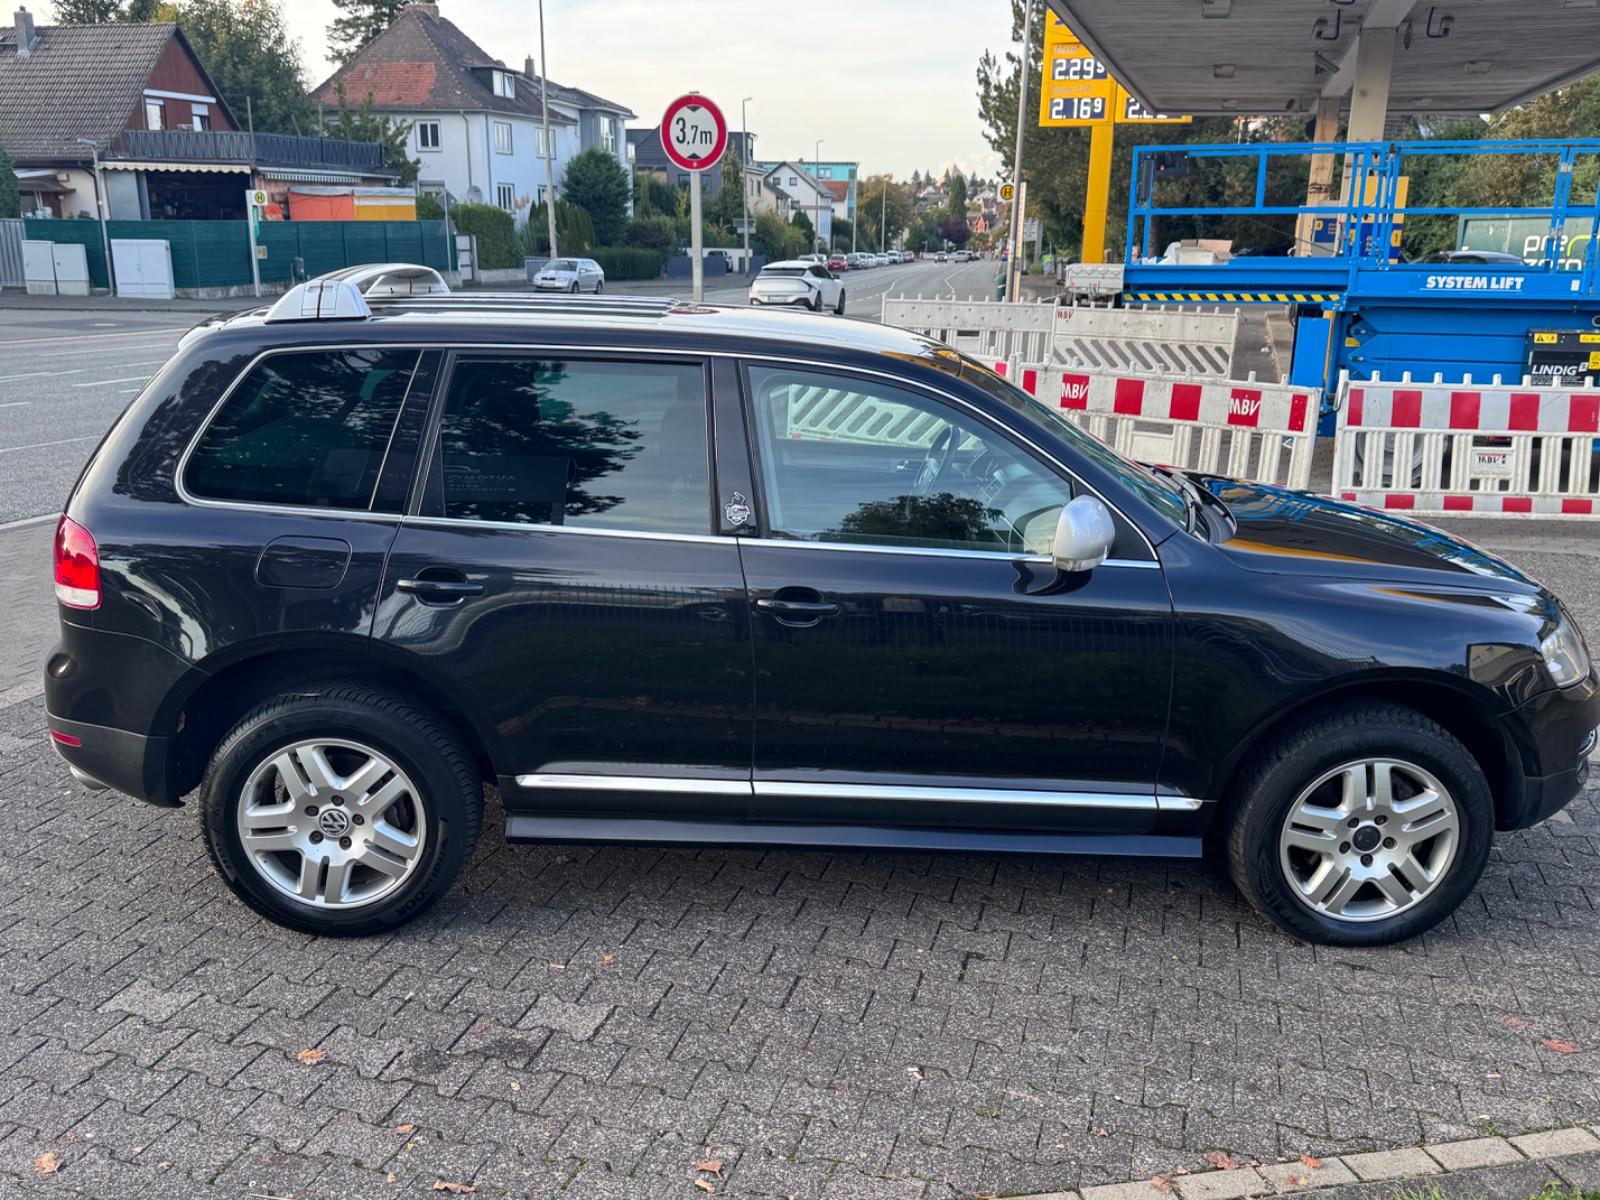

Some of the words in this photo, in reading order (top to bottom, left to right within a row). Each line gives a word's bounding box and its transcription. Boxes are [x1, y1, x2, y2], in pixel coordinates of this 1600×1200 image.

[1426, 276, 1488, 289] SYSTEM
[1490, 277, 1525, 289] LIFT
[1531, 364, 1579, 376] LINDIG
[1061, 382, 1089, 400] MBV
[1229, 397, 1261, 416] MBV
